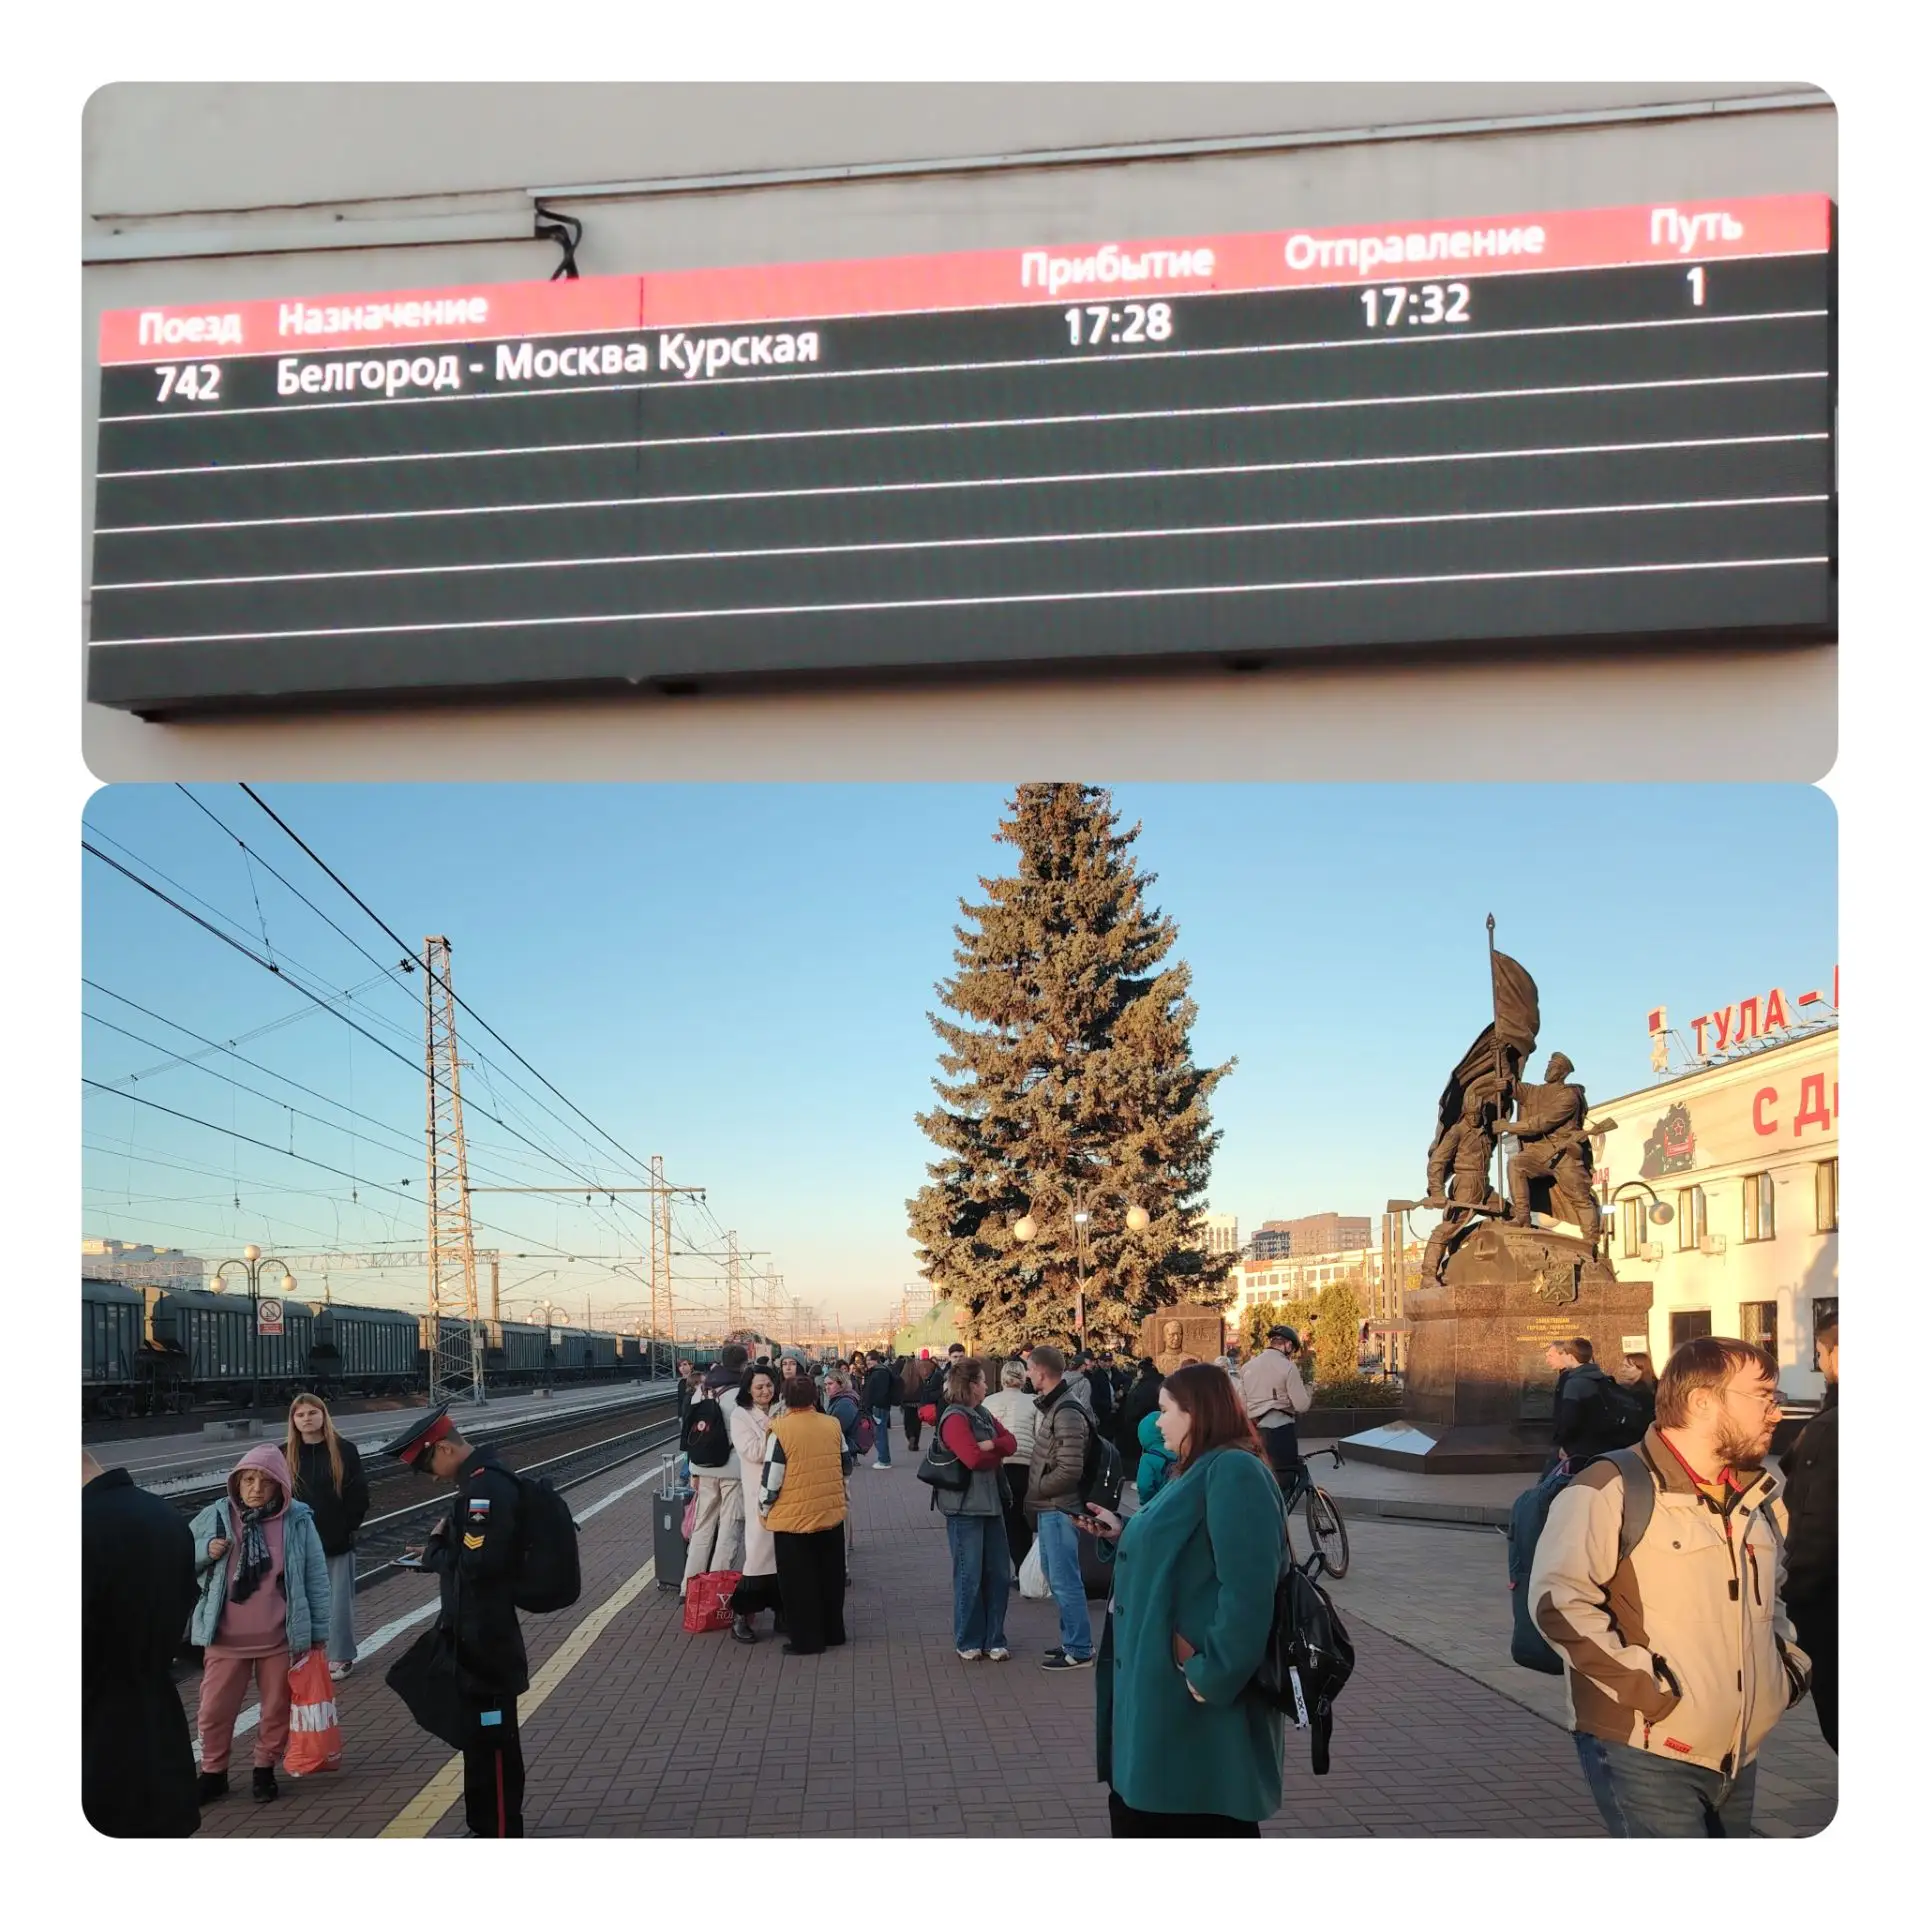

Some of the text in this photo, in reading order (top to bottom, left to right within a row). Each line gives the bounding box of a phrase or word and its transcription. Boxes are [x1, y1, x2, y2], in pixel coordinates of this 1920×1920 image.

[138, 207, 1744, 348] Поезд Назначение Прибытие Отправление Путь
[155, 364, 221, 403] 742
[276, 351, 462, 402] Белгород
[494, 340, 648, 380] Москва
[657, 327, 820, 380] Курская
[1065, 304, 1173, 346] 17:28
[1362, 284, 1470, 328] 17:32
[1686, 268, 1704, 306] 1
[1691, 988, 1788, 1056] ТУЛА
[1752, 1086, 1779, 1137] С
